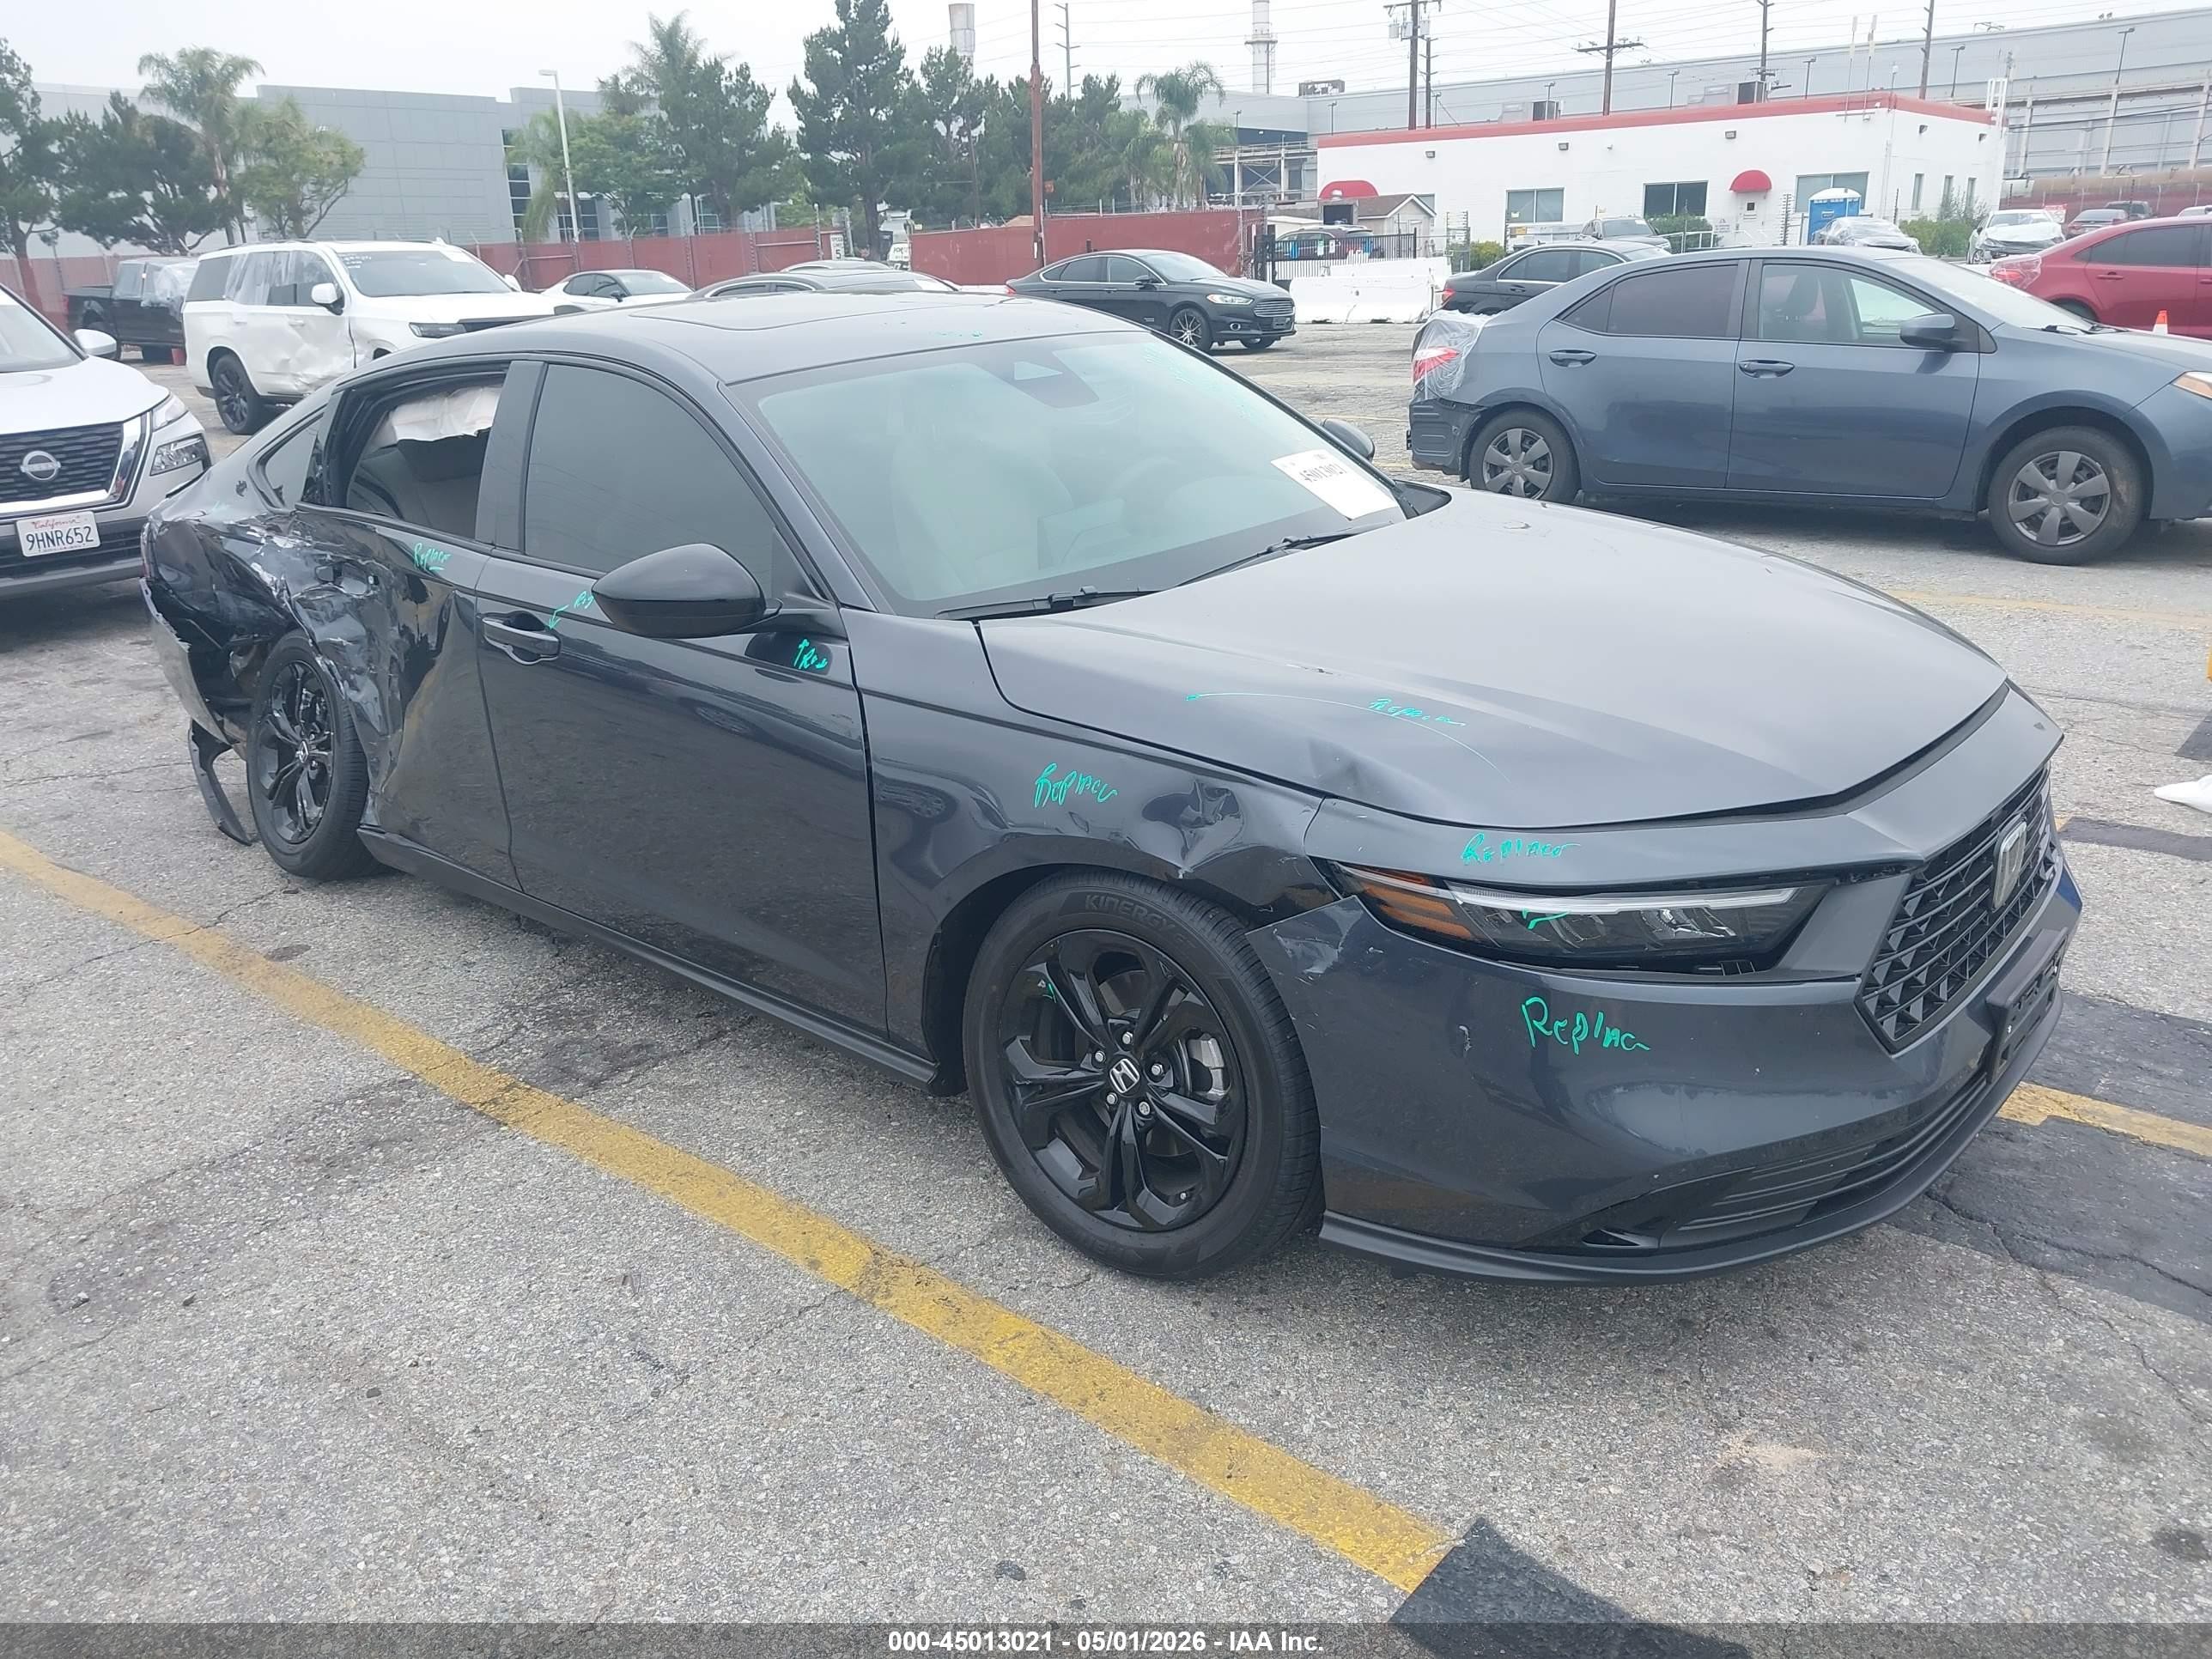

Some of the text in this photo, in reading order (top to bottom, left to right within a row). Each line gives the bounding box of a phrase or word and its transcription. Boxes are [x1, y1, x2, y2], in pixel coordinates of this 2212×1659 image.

[836, 249, 842, 259] 5
[32, 518, 80, 530] California
[26, 526, 94, 551] 9HNR652
[1085, 894, 1176, 932] KINERGY
